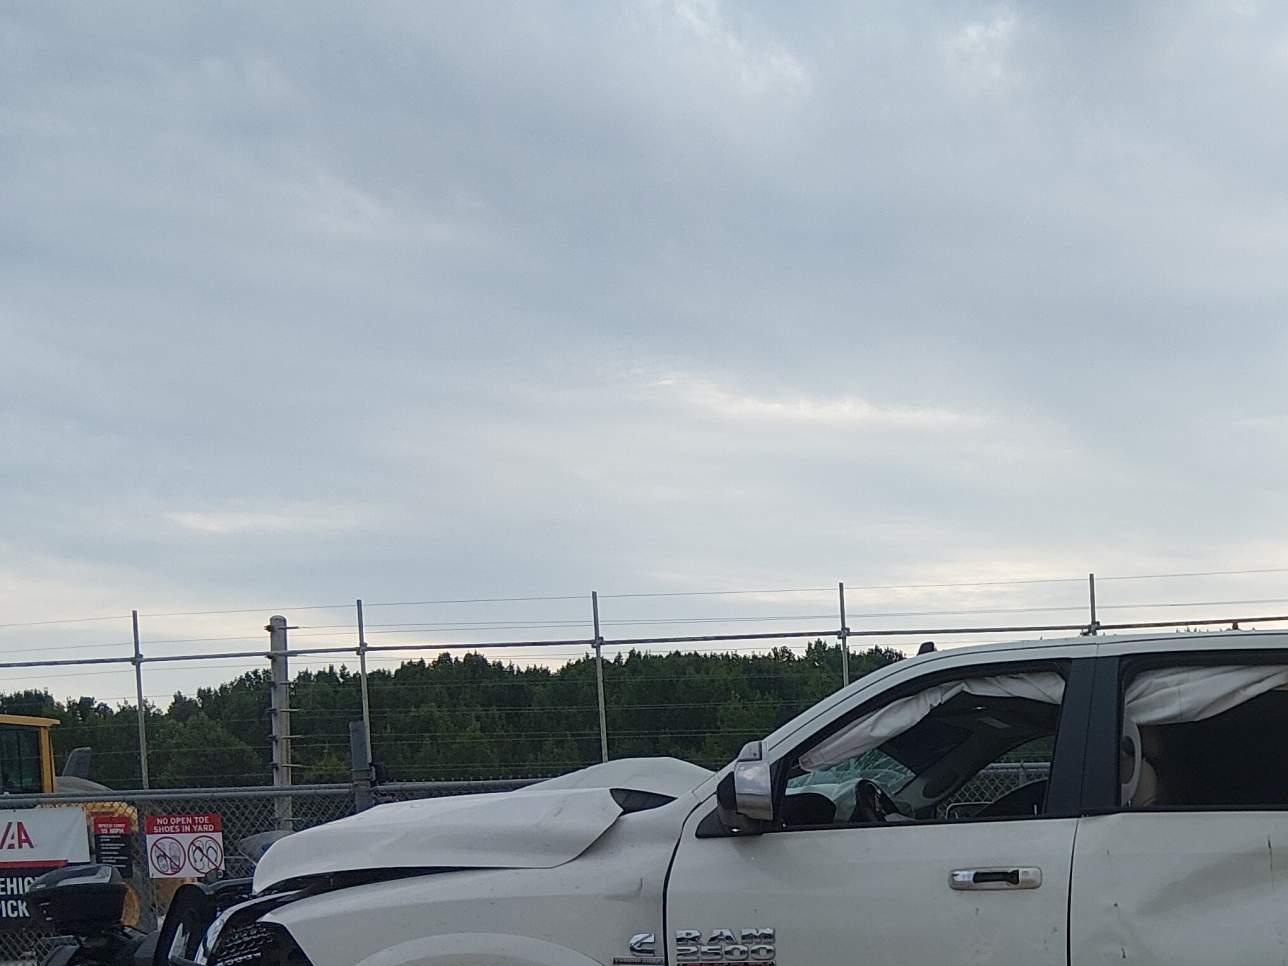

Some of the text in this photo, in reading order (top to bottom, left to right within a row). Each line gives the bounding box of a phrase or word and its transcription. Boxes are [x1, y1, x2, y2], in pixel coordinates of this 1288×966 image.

[153, 823, 214, 833] SHOES IN YARD
[156, 816, 209, 825] NO OPEN TOE
[0, 876, 38, 895] EHIC
[0, 899, 31, 918] ICK
[675, 928, 775, 944] RAM
[676, 945, 776, 961] 2500
